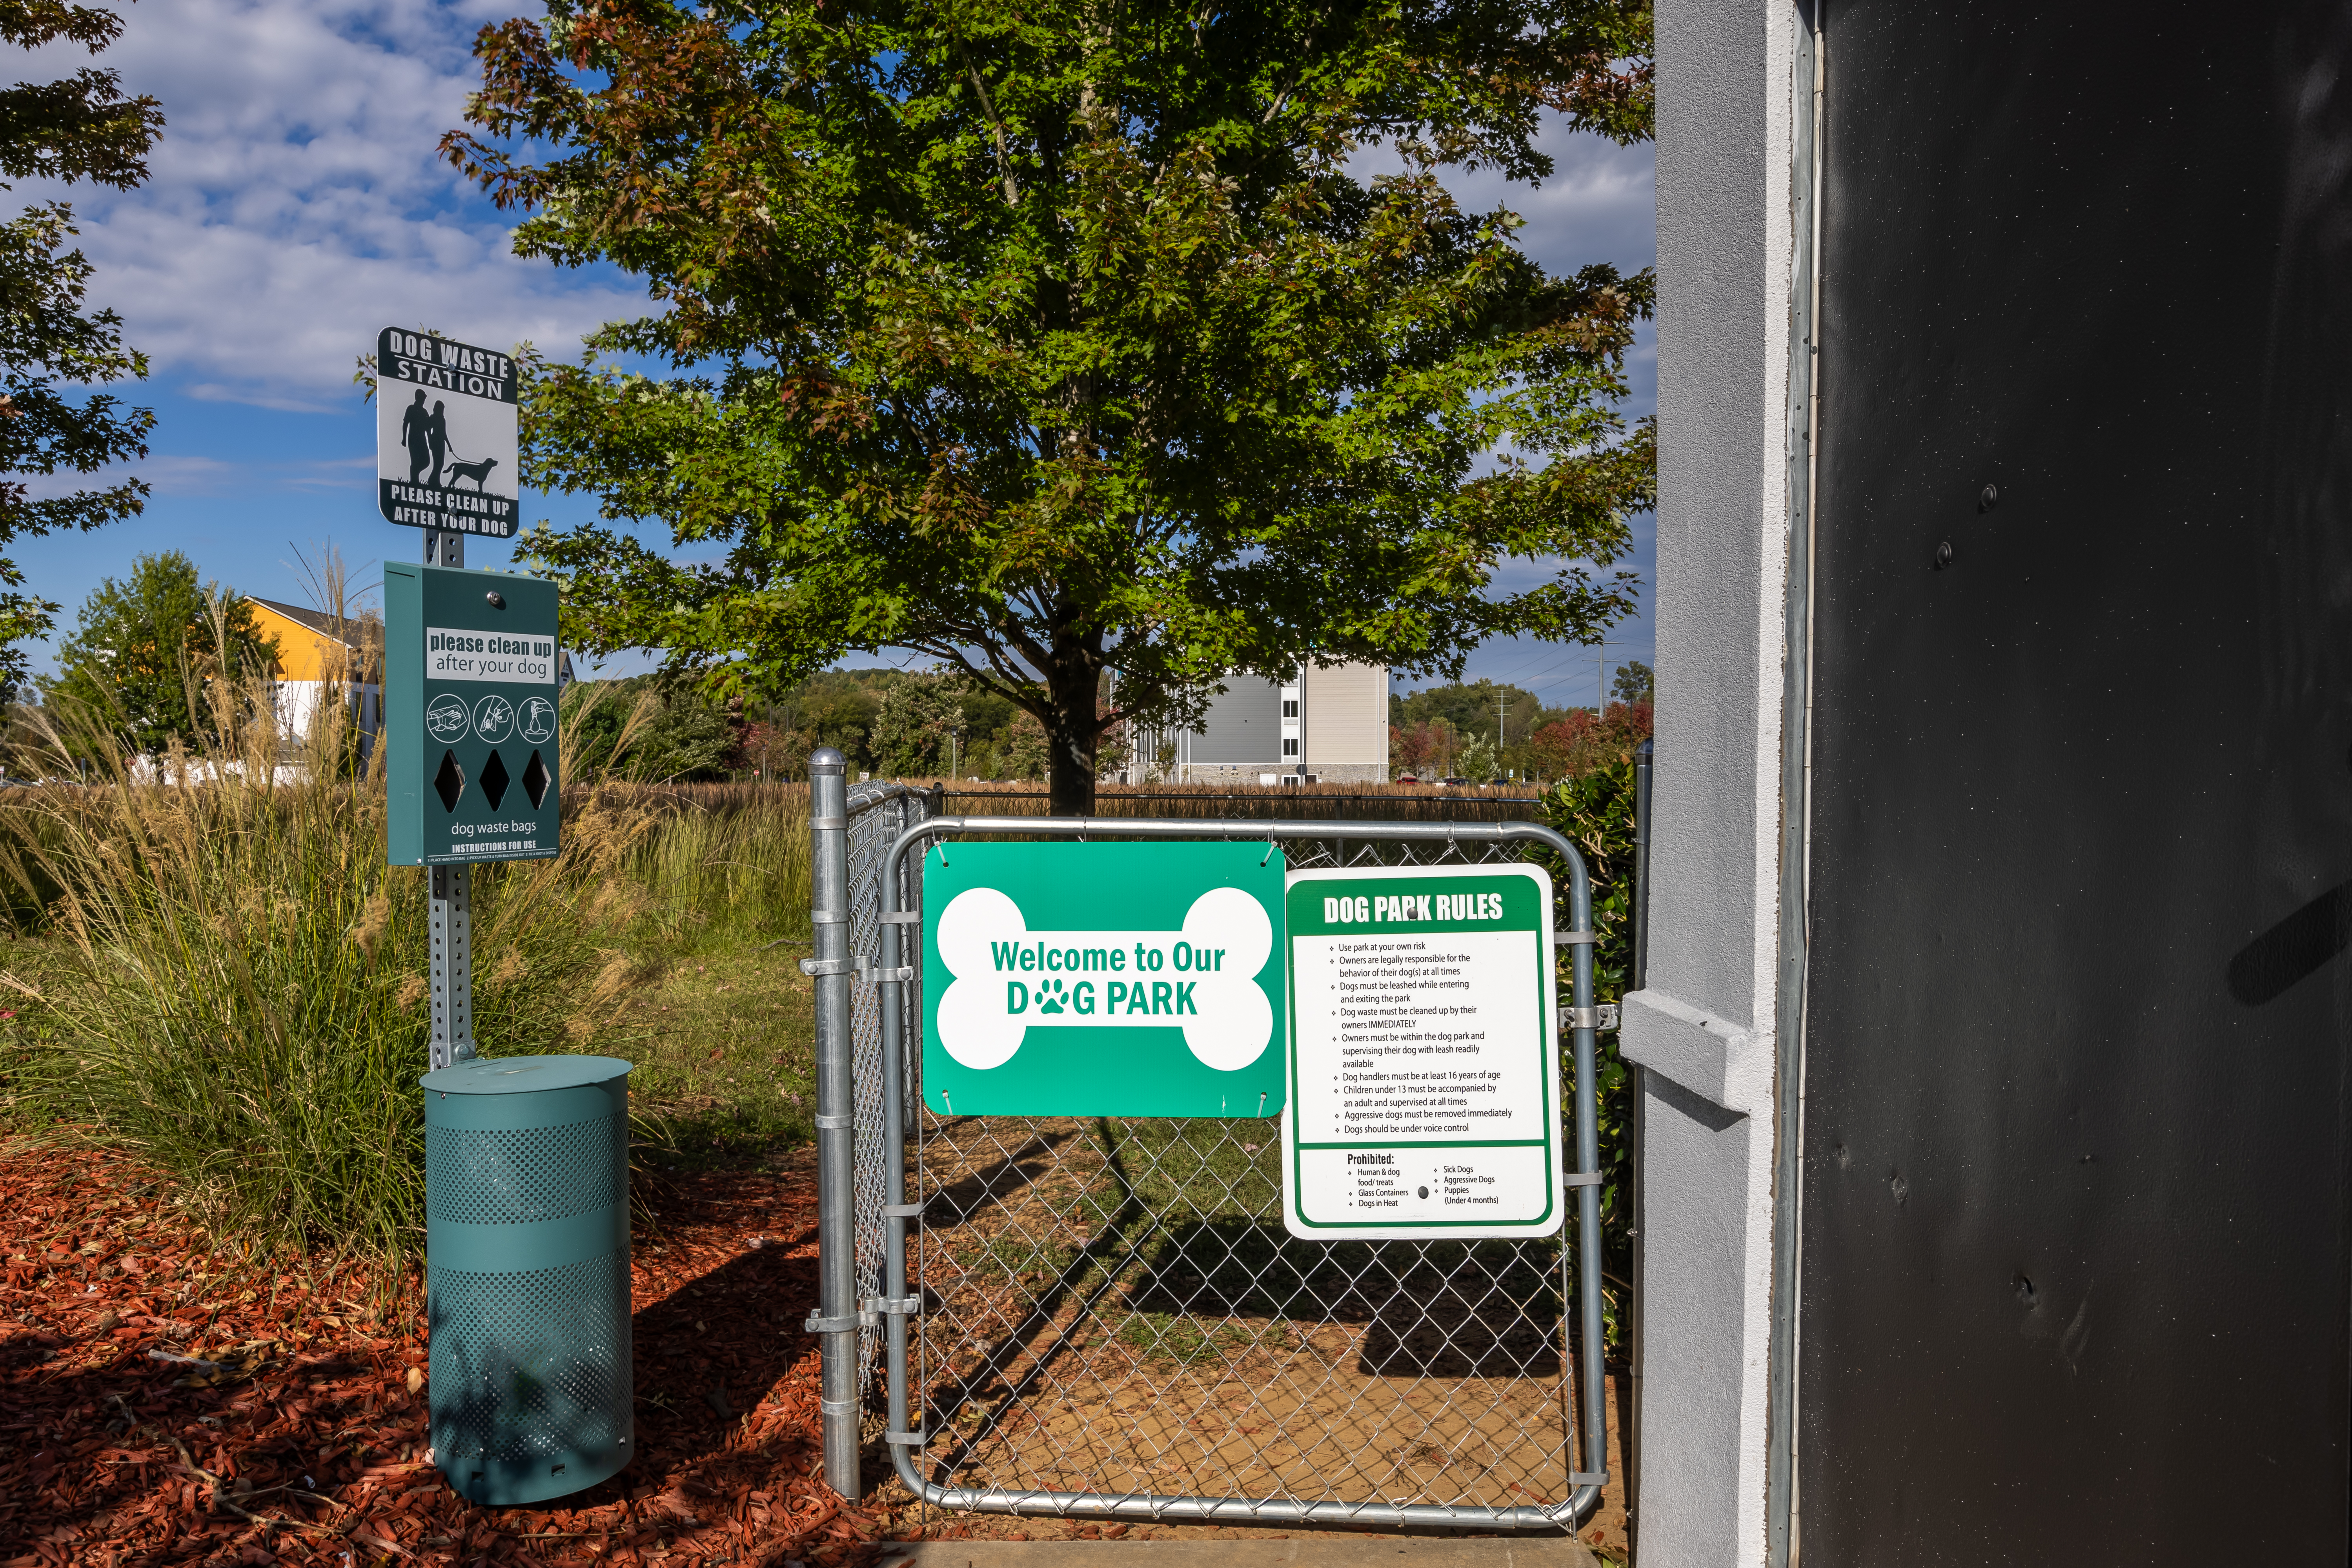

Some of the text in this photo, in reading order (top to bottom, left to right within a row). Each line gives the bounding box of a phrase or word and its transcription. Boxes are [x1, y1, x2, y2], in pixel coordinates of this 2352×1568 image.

[390, 331, 508, 379] DOG WASTE
[398, 361, 501, 399] STATION
[391, 484, 509, 516] PLEASE CLEAN UP
[394, 506, 507, 535] AFTER YOUR DOG
[430, 633, 551, 658] please clean up
[437, 654, 546, 679] after your dog
[451, 820, 536, 837] dog waste bags
[452, 840, 536, 853] INSTRUCTIONS FOR USE
[1324, 893, 1503, 923] DOG PARK RULES
[1353, 943, 1369, 953] park
[1378, 944, 1395, 953] your
[1413, 941, 1426, 950] risk
[991, 941, 1225, 972] Welcome to Our
[1339, 956, 1366, 964] Owners
[1380, 955, 1404, 965] legally
[1405, 954, 1445, 965] responsible
[1447, 954, 1457, 962] for
[1458, 953, 1470, 962] the
[1340, 969, 1371, 977] behavior
[1372, 968, 1380, 976] of
[1380, 968, 1397, 976] their
[1399, 967, 1421, 978] dog(s)
[1431, 967, 1439, 975] all
[1440, 967, 1460, 975] times
[1340, 982, 1358, 992] Dogs
[1379, 981, 1388, 989] be
[1390, 980, 1417, 989] leashed
[1418, 980, 1438, 989] while
[1439, 980, 1469, 990] entering
[1008, 979, 1198, 1015] DG PARK
[1341, 993, 1411, 1005] and exiting the park
[1341, 1008, 1356, 1018] Dog
[1399, 1007, 1408, 1015] be
[1409, 1006, 1437, 1015] cleaned
[1439, 1008, 1448, 1016] up
[1450, 1005, 1459, 1016] by
[1460, 1005, 1477, 1014] their
[1369, 1020, 1416, 1028] IMMEDIATELY
[1342, 1034, 1369, 1042] Owners
[1390, 1033, 1399, 1041] be
[1400, 1032, 1423, 1041] within
[1424, 1032, 1436, 1040] the
[1438, 1032, 1452, 1042] dog
[1454, 1031, 1470, 1042] park
[1471, 1031, 1484, 1040] and
[1342, 1044, 1480, 1057] supervising their dog with leash readily
[1343, 1059, 1374, 1068] available
[1343, 1073, 1358, 1083] Dog
[1360, 1072, 1390, 1081] handlers
[1411, 1071, 1420, 1080] be
[1430, 1071, 1447, 1080] least
[1449, 1071, 1457, 1079] 16
[1458, 1073, 1477, 1081] years
[1478, 1070, 1486, 1079] of
[1487, 1072, 1501, 1081] age
[1343, 1085, 1373, 1094] Children
[1375, 1085, 1396, 1093] under
[1427, 1084, 1436, 1093] be
[1438, 1083, 1486, 1094] accompanied
[1487, 1083, 1496, 1094] by
[1354, 1098, 1373, 1107] adult
[1374, 1098, 1388, 1107] and
[1389, 1097, 1427, 1108] supervised
[1438, 1097, 1446, 1105] all
[1447, 1097, 1467, 1105] times
[1344, 1111, 1383, 1121] Aggressive
[1385, 1110, 1403, 1120] dogs
[1424, 1109, 1433, 1118] be
[1435, 1109, 1466, 1118] removed
[1468, 1108, 1512, 1119] immediately
[1345, 1123, 1469, 1135] Dogs should be under voice control
[1347, 1153, 1394, 1165] Prohibited:
[1387, 1168, 1400, 1177] dog
[1457, 1166, 1473, 1175] Dogs
[1444, 1175, 1495, 1185] Aggressive Dogs
[1444, 1186, 1469, 1195] Puppies
[1359, 1199, 1375, 1209] Dogs
[1445, 1196, 1466, 1205] (Under
[1473, 1196, 1498, 1204] months)
